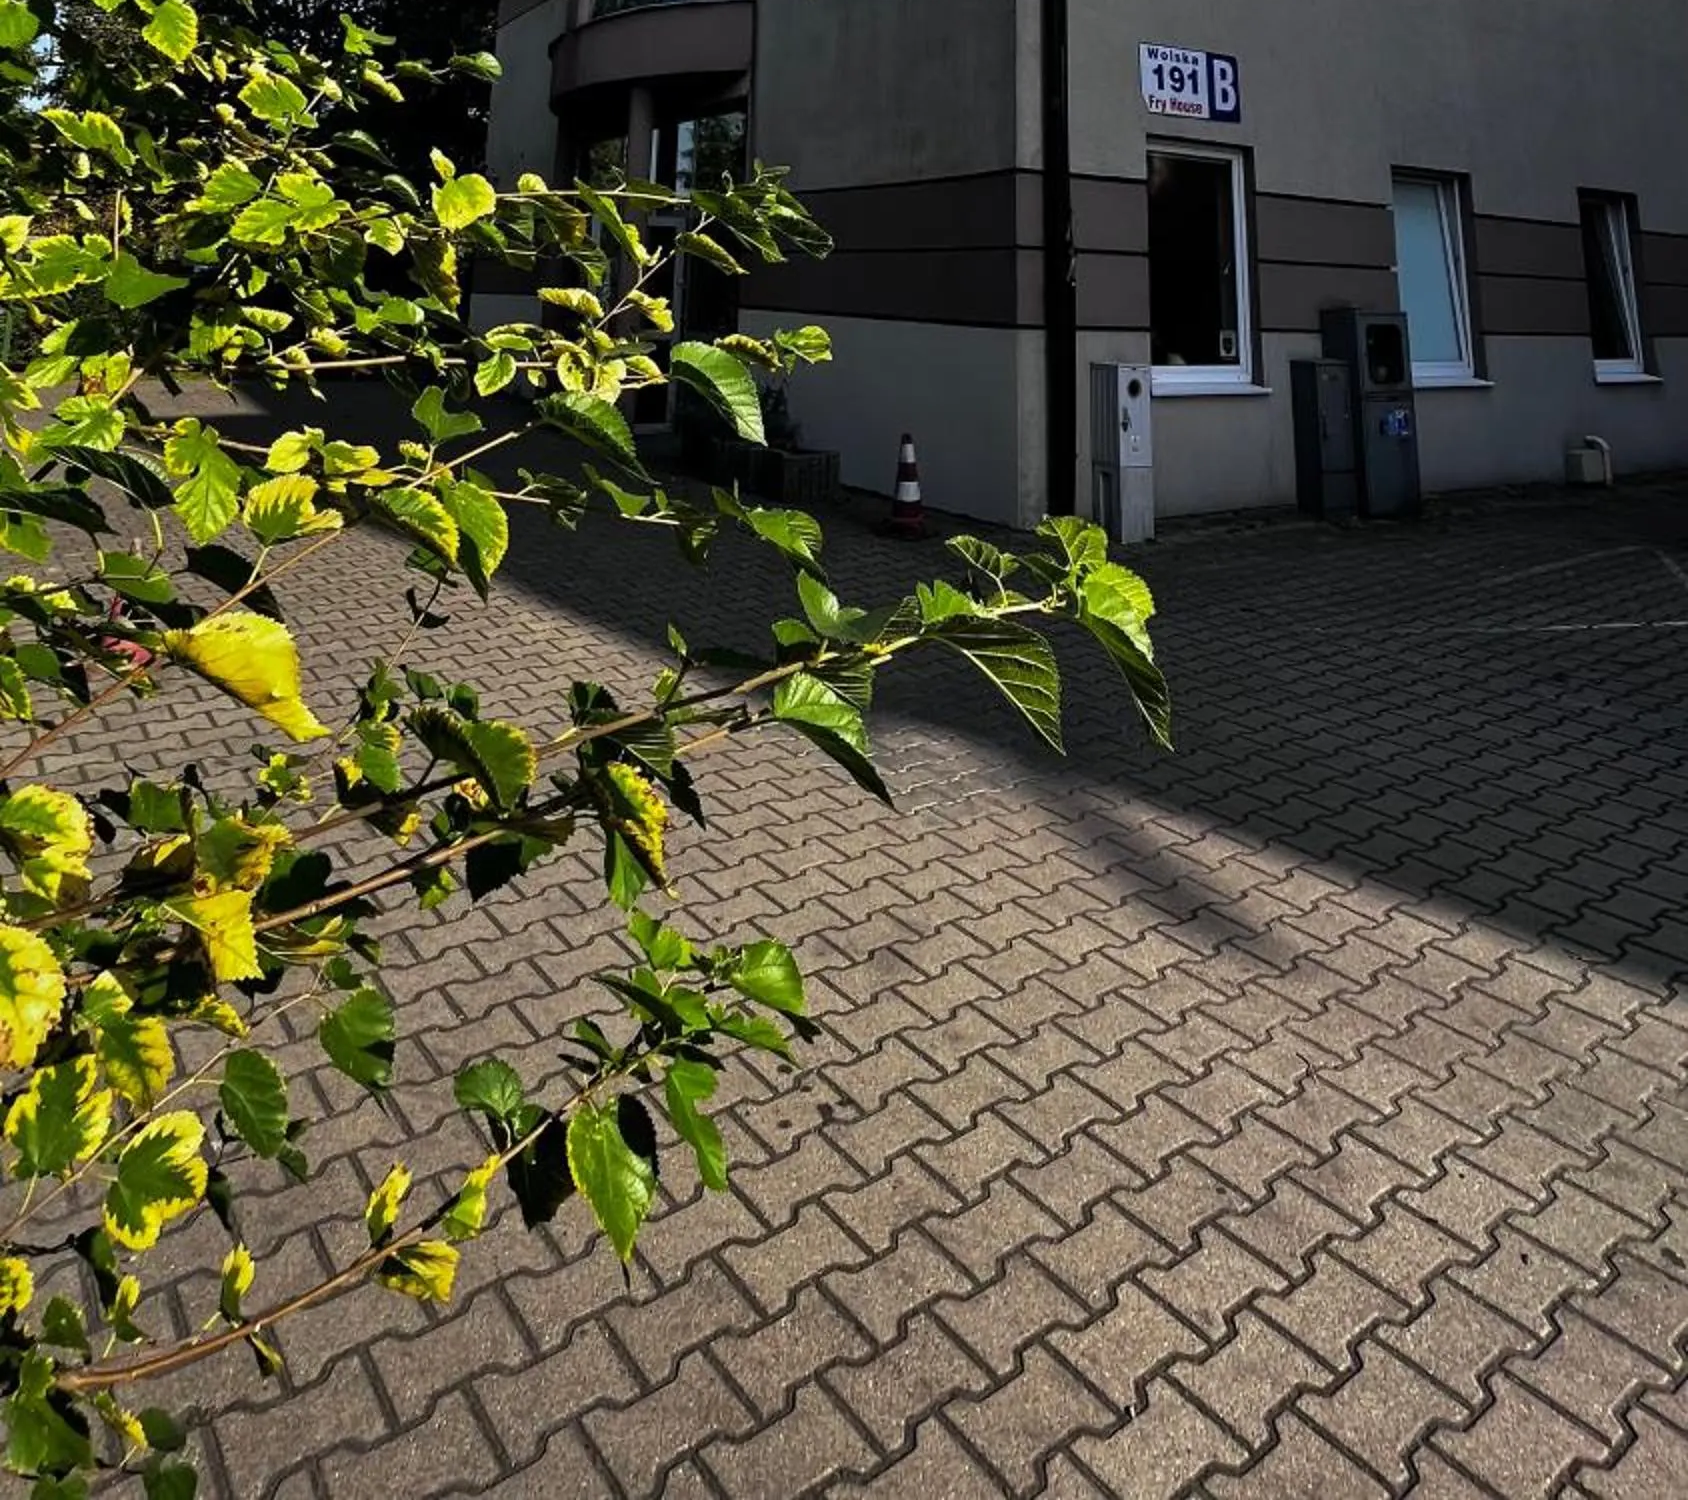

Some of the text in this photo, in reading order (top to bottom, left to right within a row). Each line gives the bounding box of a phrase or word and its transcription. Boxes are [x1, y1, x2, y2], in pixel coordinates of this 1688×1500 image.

[1147, 47, 1199, 66] Wolska
[1152, 59, 1237, 111] 191 B
[1148, 95, 1203, 115] Fry House
